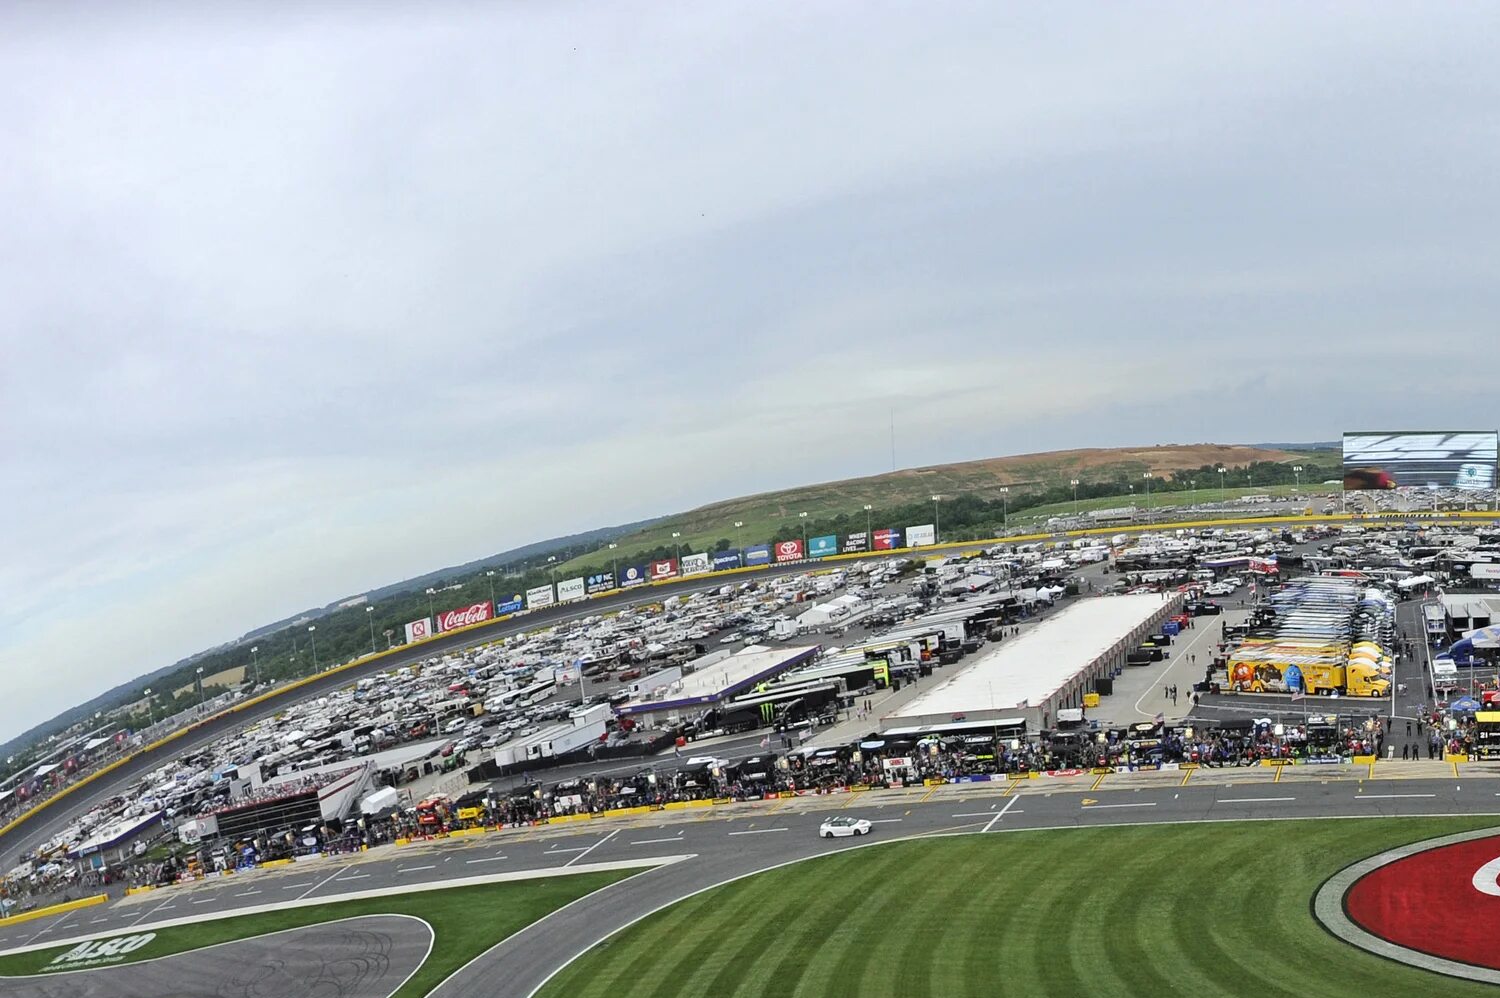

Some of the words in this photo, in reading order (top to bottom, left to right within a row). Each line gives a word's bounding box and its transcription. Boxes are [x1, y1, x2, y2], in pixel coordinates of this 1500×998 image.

[714, 555, 738, 565] Spectrum
[777, 552, 803, 562] TOYOTA
[603, 573, 613, 581] NC
[444, 601, 489, 630] Coca-Cola
